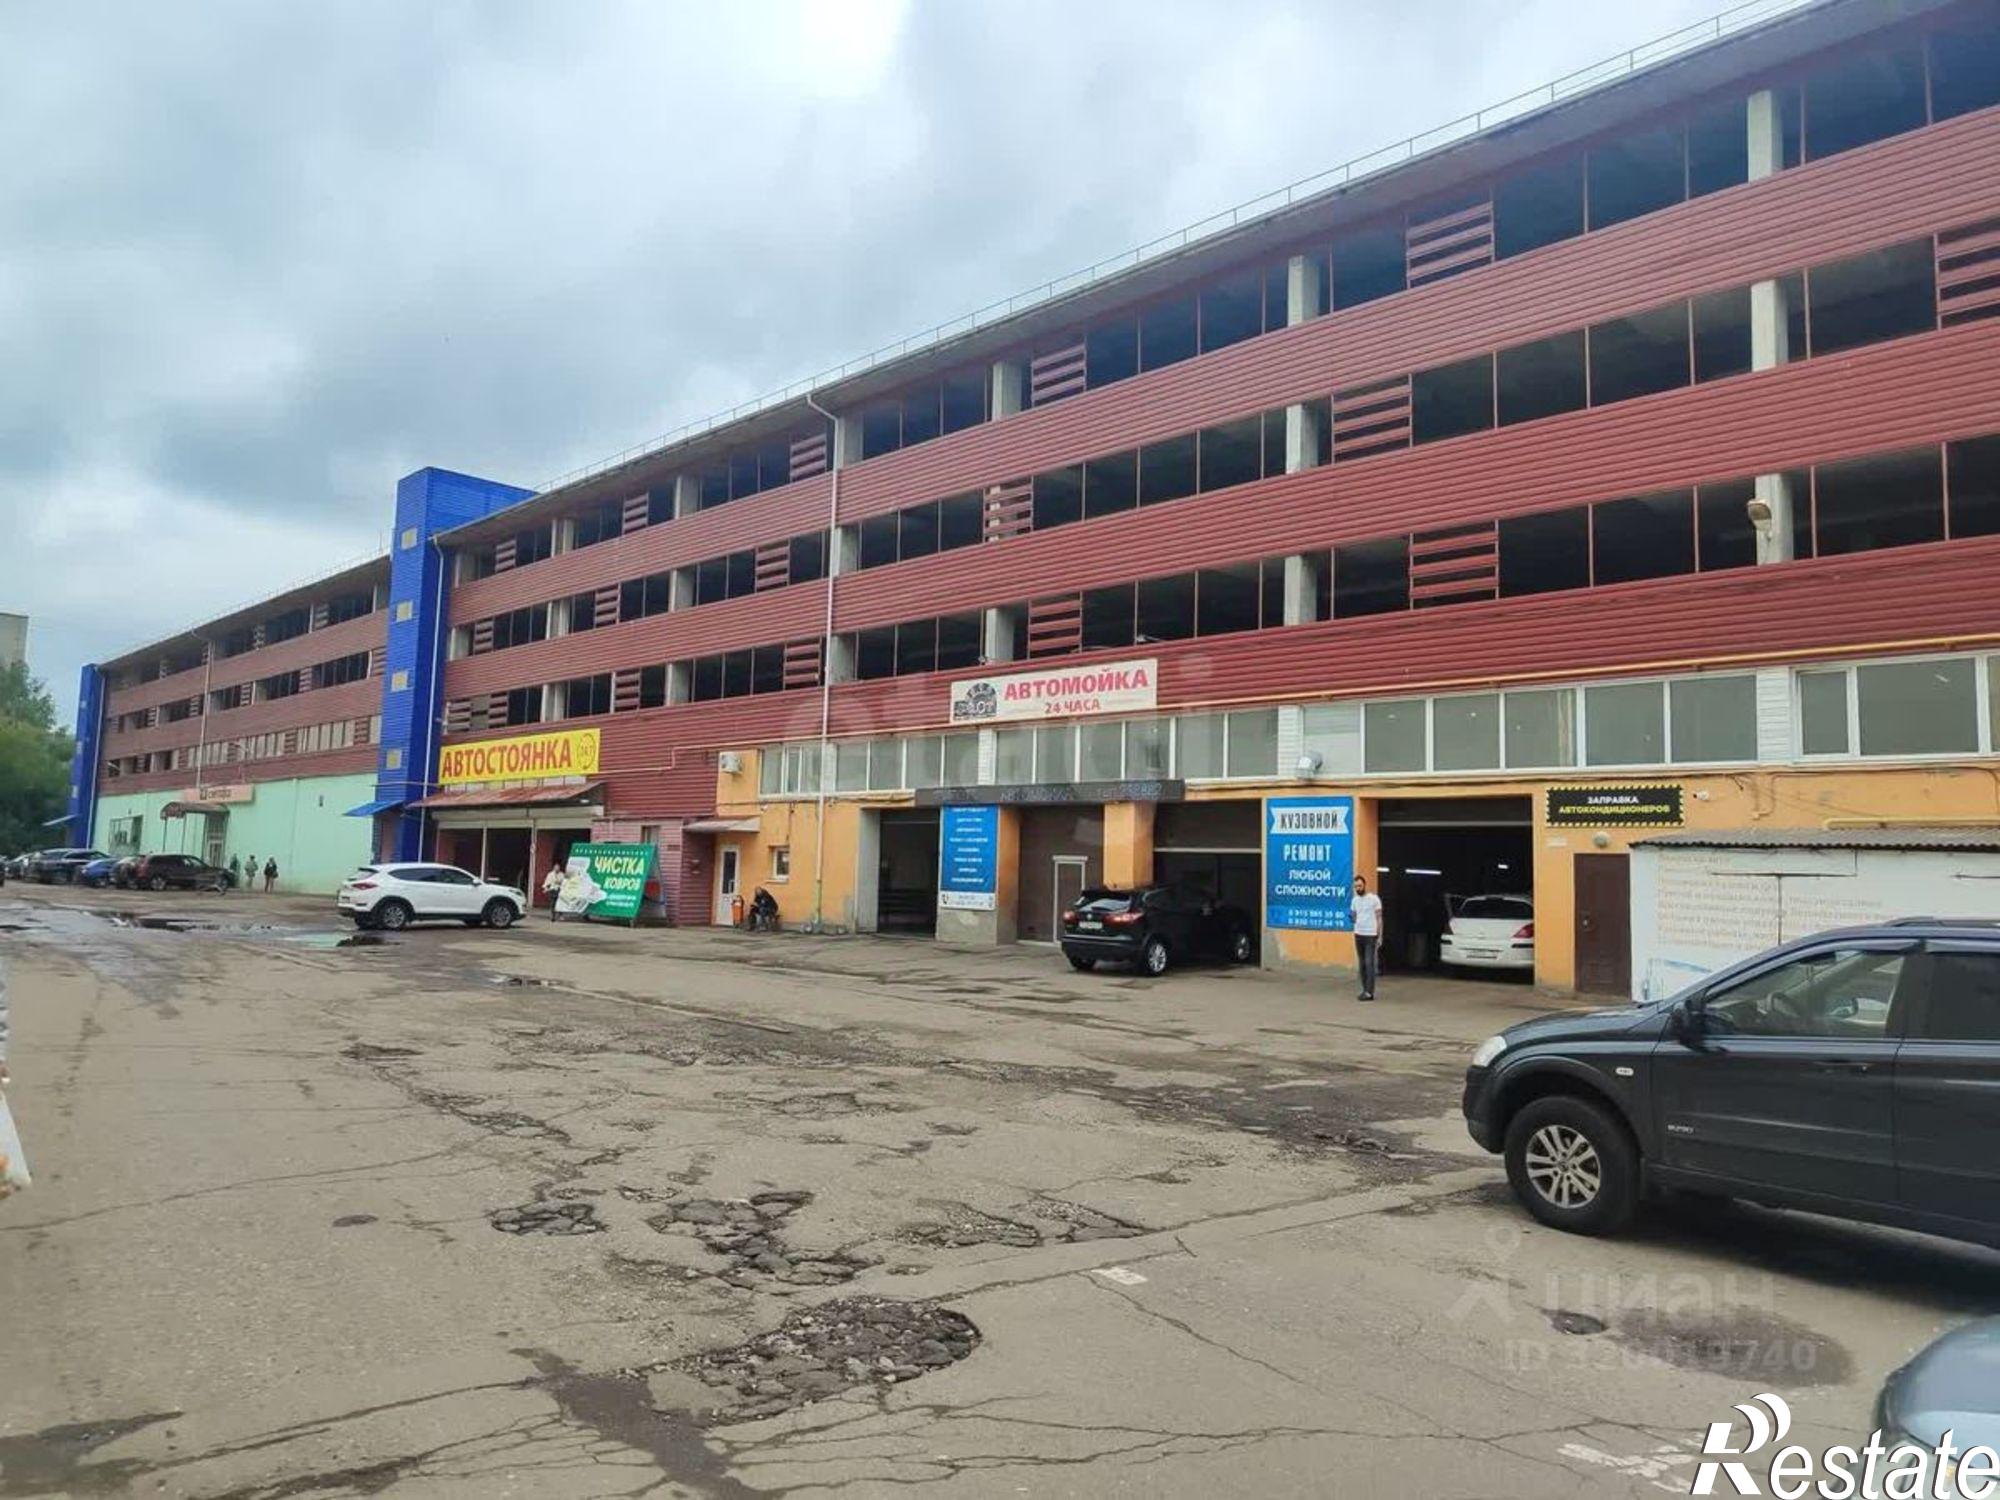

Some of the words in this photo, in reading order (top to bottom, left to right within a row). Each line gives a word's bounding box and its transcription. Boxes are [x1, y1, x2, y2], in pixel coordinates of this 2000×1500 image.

[1005, 668, 1149, 701] АВТОМОЙКА
[1045, 701, 1061, 714] 24
[1064, 699, 1101, 713] ЧАСА
[442, 738, 572, 778] АВТОСТОЯНКА
[1587, 796, 1639, 804] ЗАПРАВКА
[1559, 805, 1670, 814] АВТОКОНДИЦИОНЕРОВ
[1280, 812, 1338, 829] КУЗОВНОЙ
[1284, 845, 1331, 861] РЕМОНТ
[594, 856, 645, 875] ЧИСТКА
[1289, 869, 1331, 881] ЛЮБОЙ
[1275, 885, 1346, 897] СЛОЖНОСТИ
